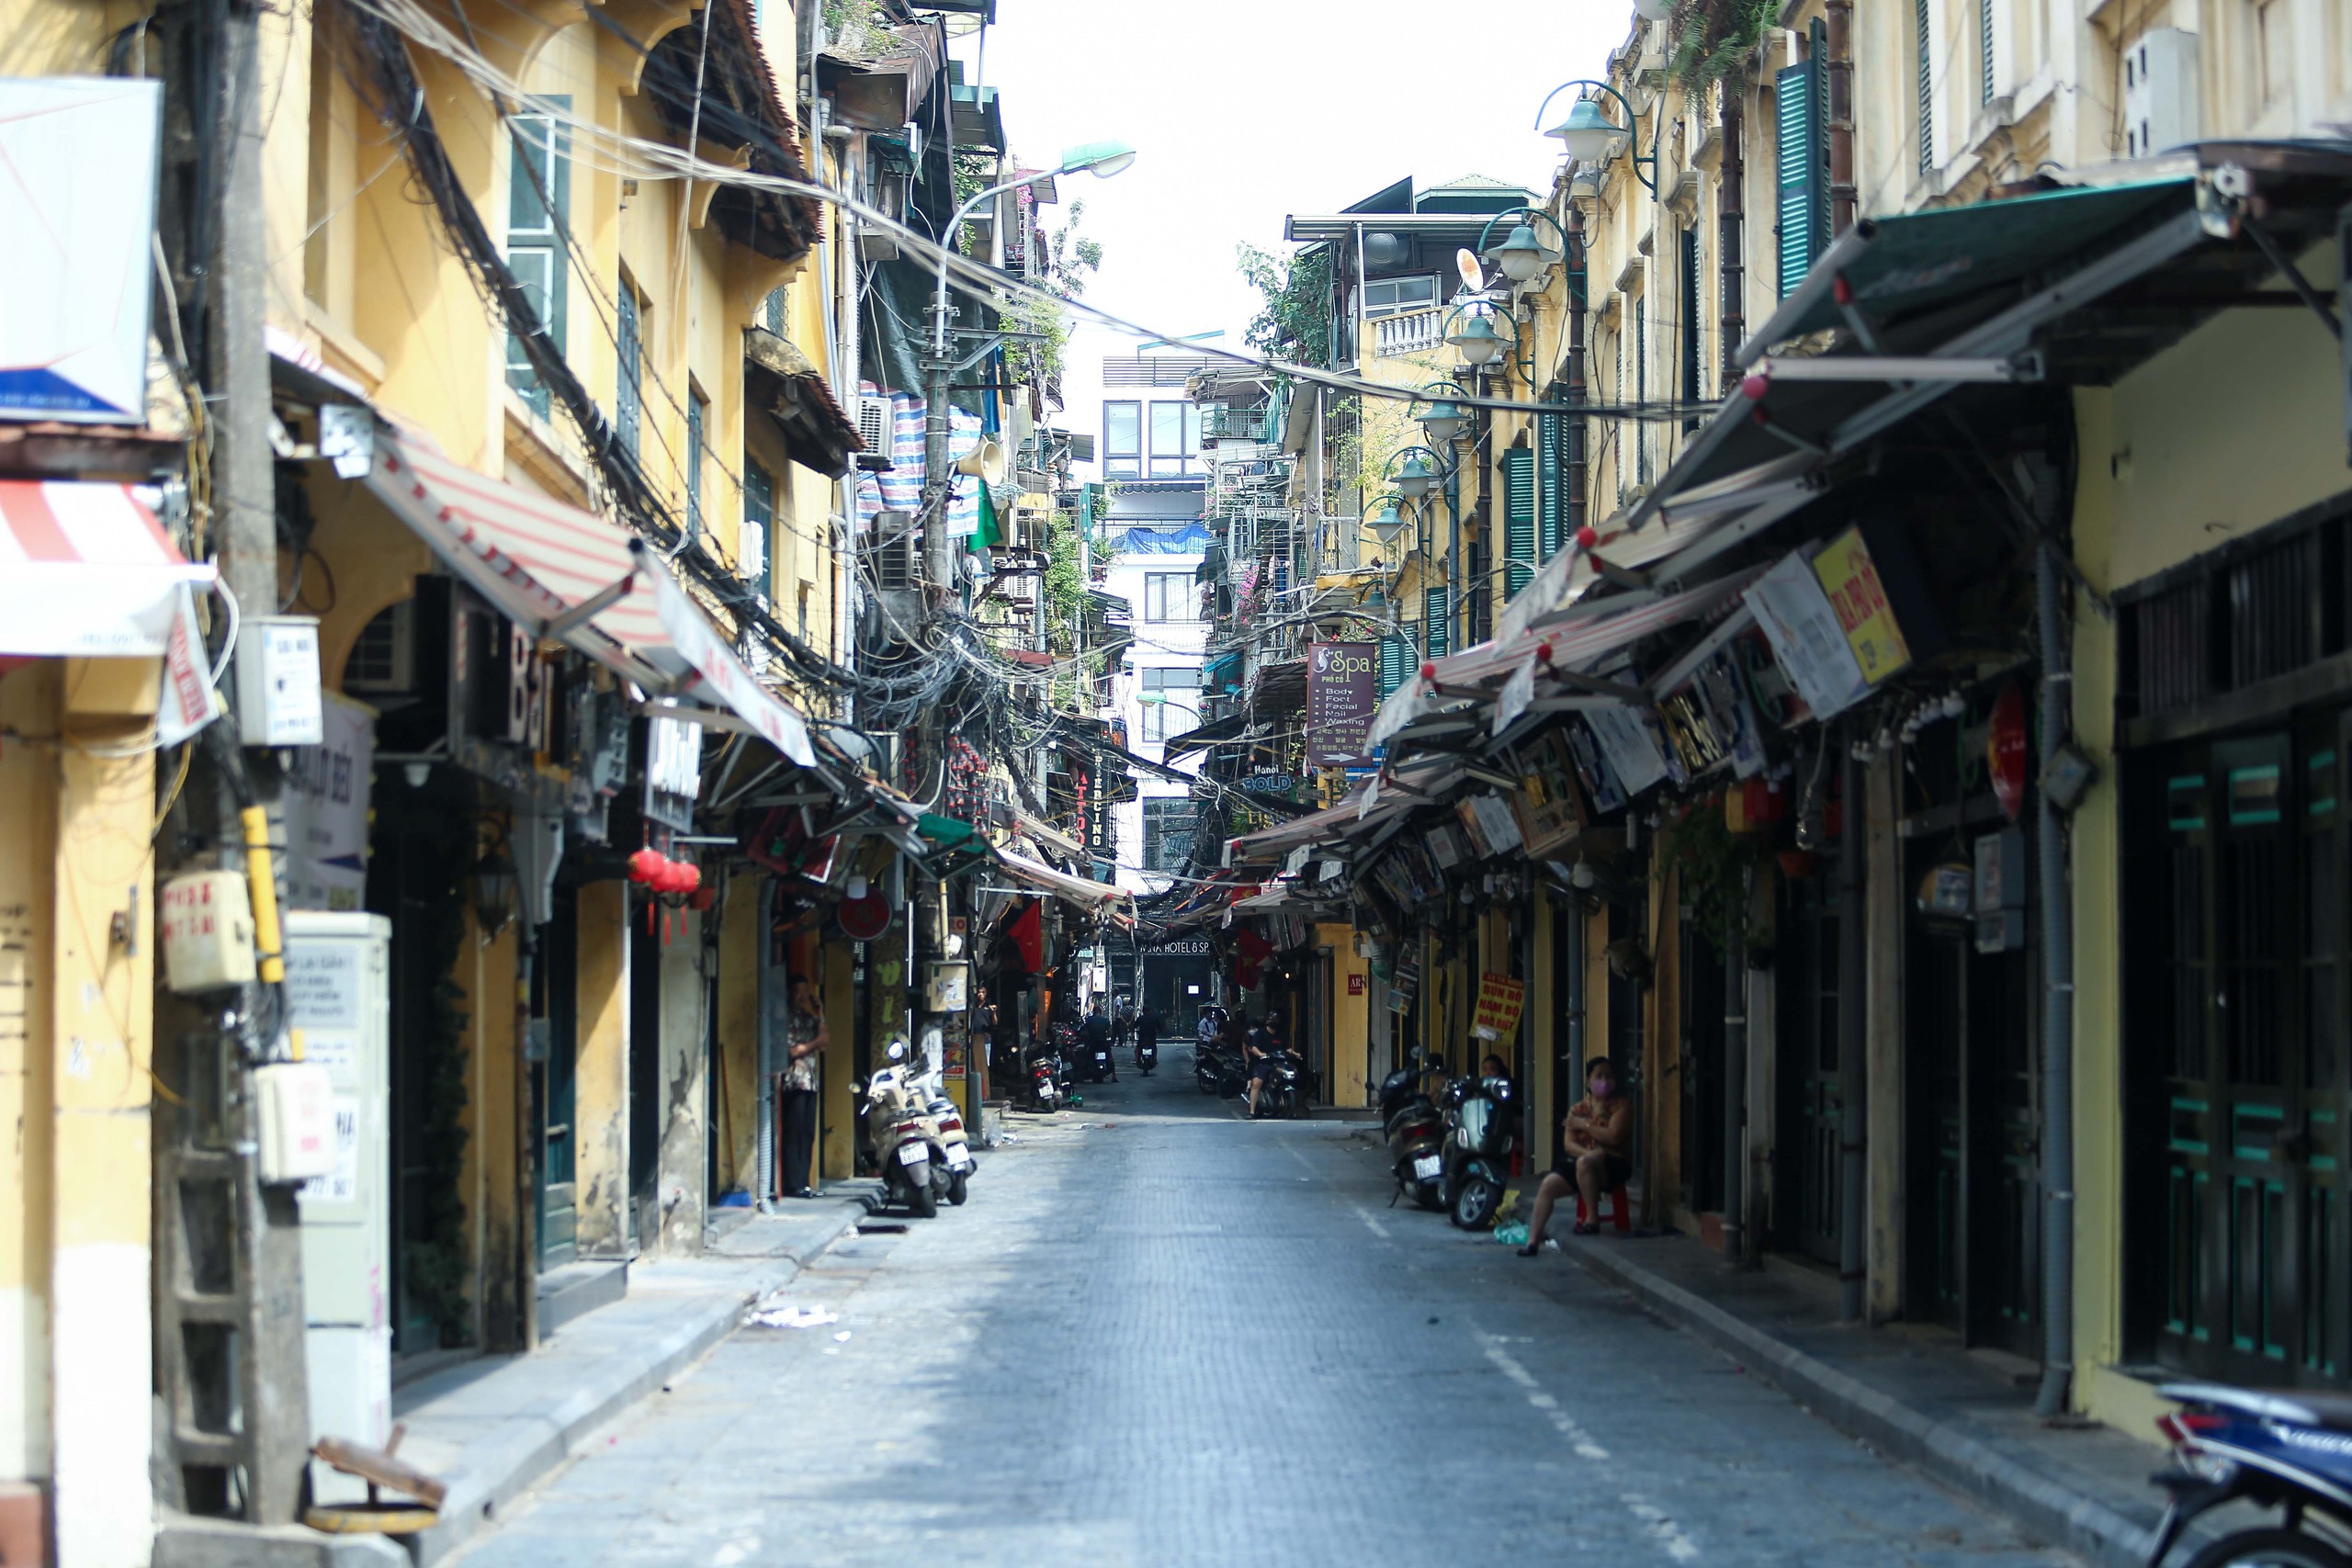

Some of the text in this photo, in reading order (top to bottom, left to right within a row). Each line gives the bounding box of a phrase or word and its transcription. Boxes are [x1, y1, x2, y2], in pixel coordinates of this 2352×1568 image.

[1330, 649, 1371, 682] Spa
[1326, 688, 1353, 696] Body
[1325, 717, 1364, 726] Waxing
[1254, 764, 1279, 774] Hanoi
[1242, 775, 1292, 793] BOLD
[1076, 770, 1088, 845] ATTOO
[1164, 942, 1191, 953] HOTEL
[1192, 942, 1197, 953] &
[1199, 942, 1210, 953] SP
